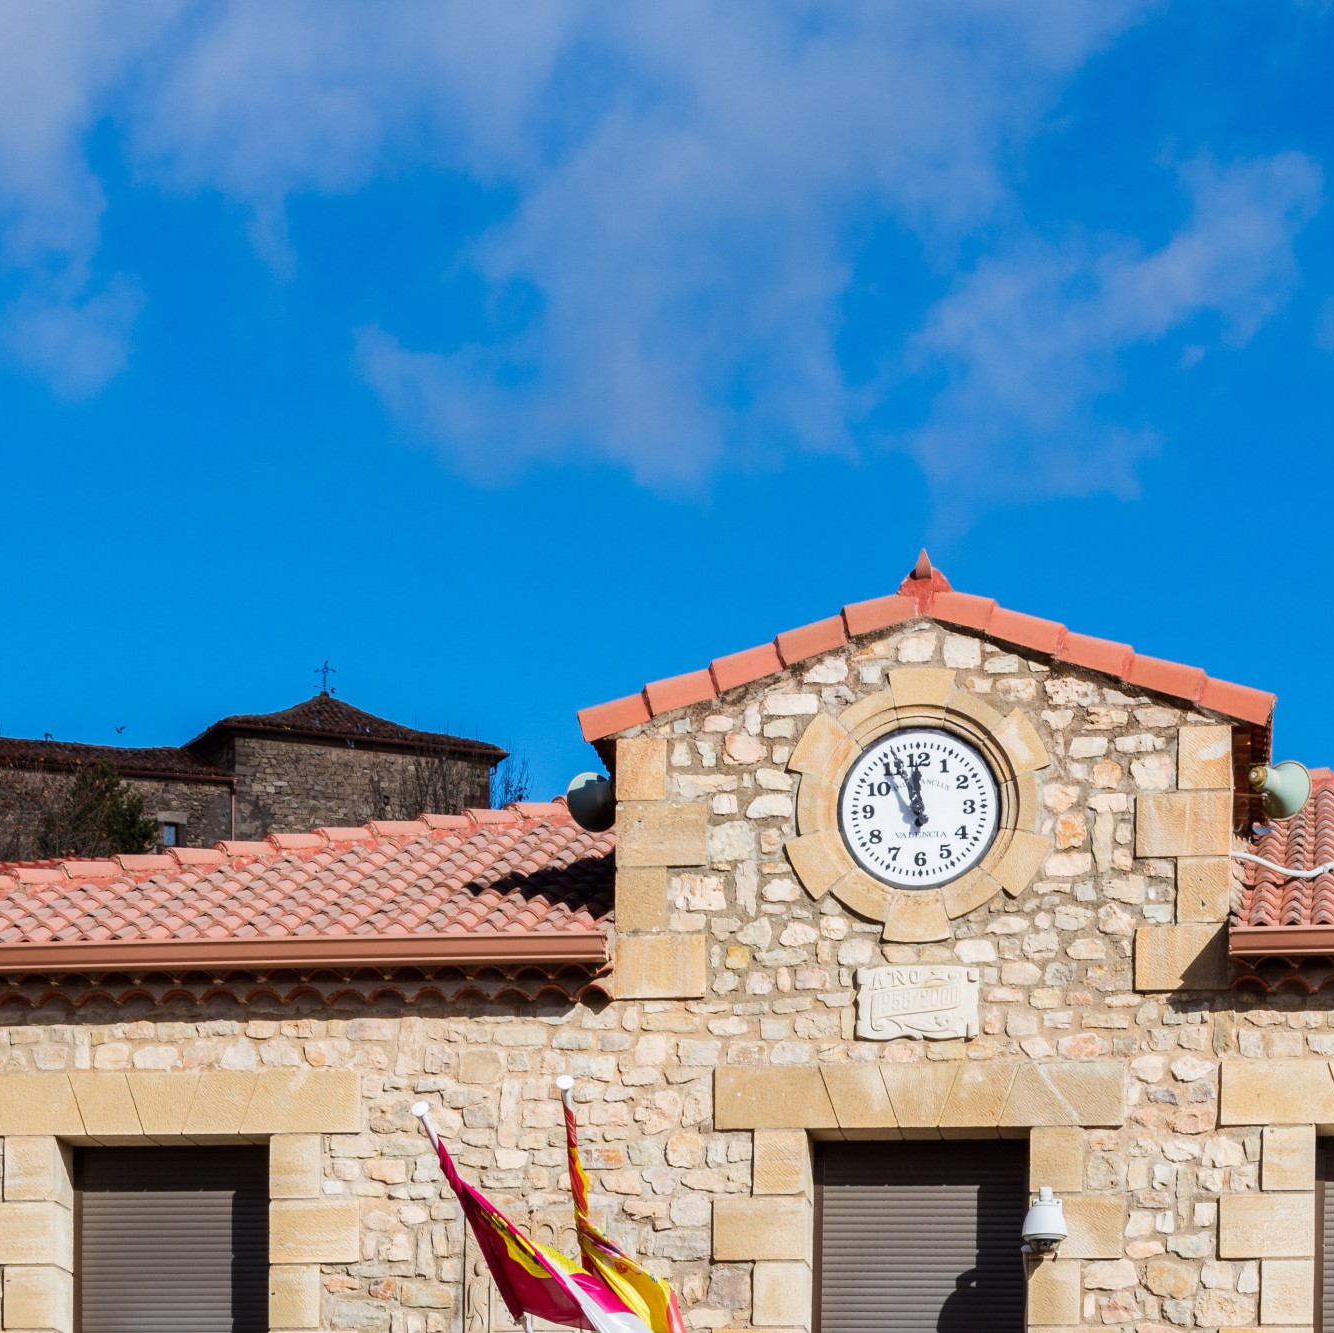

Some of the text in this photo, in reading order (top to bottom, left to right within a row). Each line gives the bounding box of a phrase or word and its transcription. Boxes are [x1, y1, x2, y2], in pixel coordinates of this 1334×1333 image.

[906, 752, 931, 768] 12
[939, 758, 950, 773] 1
[867, 781, 891, 797] 10
[956, 774, 969, 790] 2
[862, 804, 875, 819] 9
[963, 799, 976, 815] 3
[869, 829, 882, 844] 8
[894, 831, 947, 839] VALENCIA
[954, 825, 969, 840] 4
[887, 846, 901, 861] 7
[914, 851, 927, 867] 6
[939, 844, 952, 859] 5
